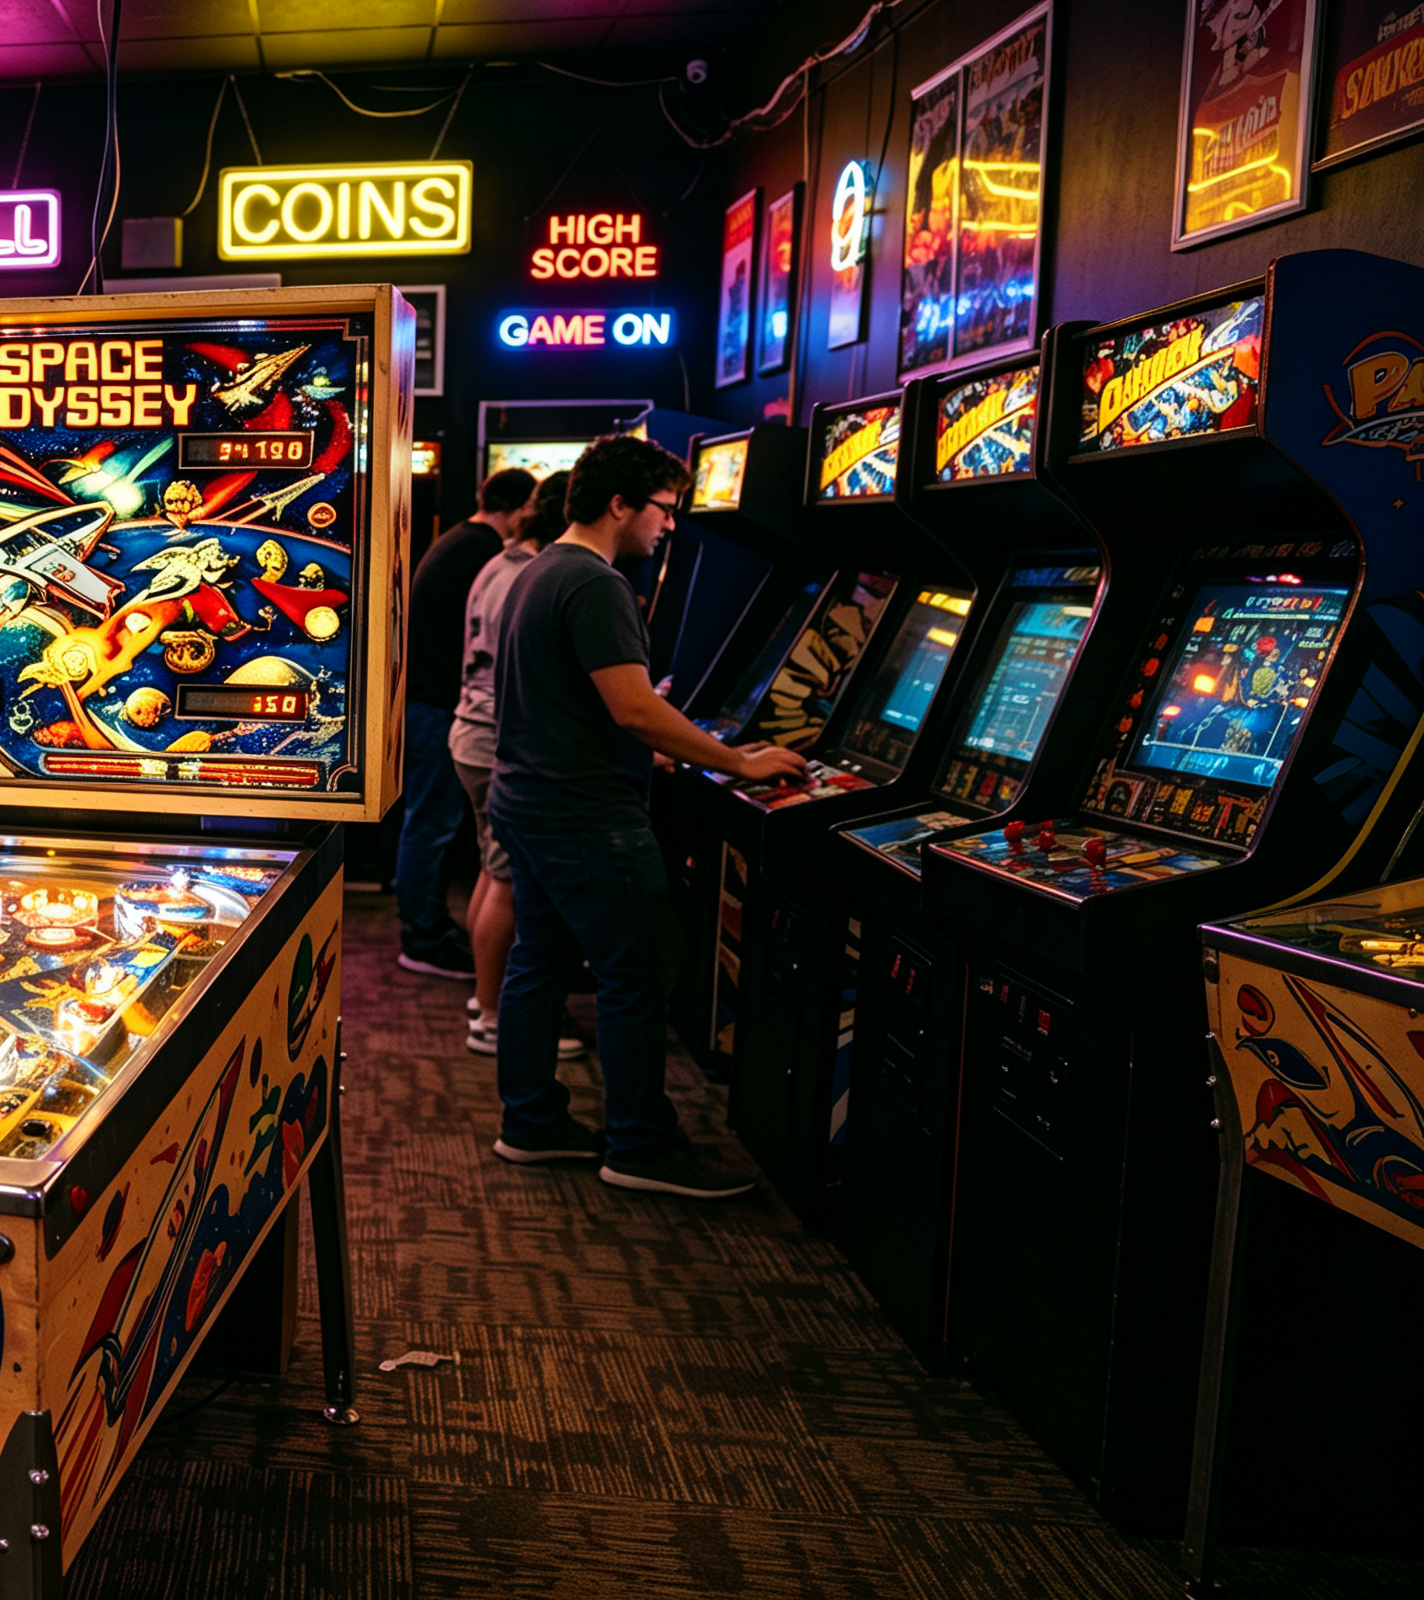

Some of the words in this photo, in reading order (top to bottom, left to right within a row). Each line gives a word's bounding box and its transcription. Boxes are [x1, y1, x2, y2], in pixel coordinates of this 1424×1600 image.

[233, 177, 456, 244] COINS
[549, 213, 641, 245] HIGH
[530, 246, 657, 279] SCORE
[499, 314, 606, 347] GAME
[612, 313, 671, 346] ON
